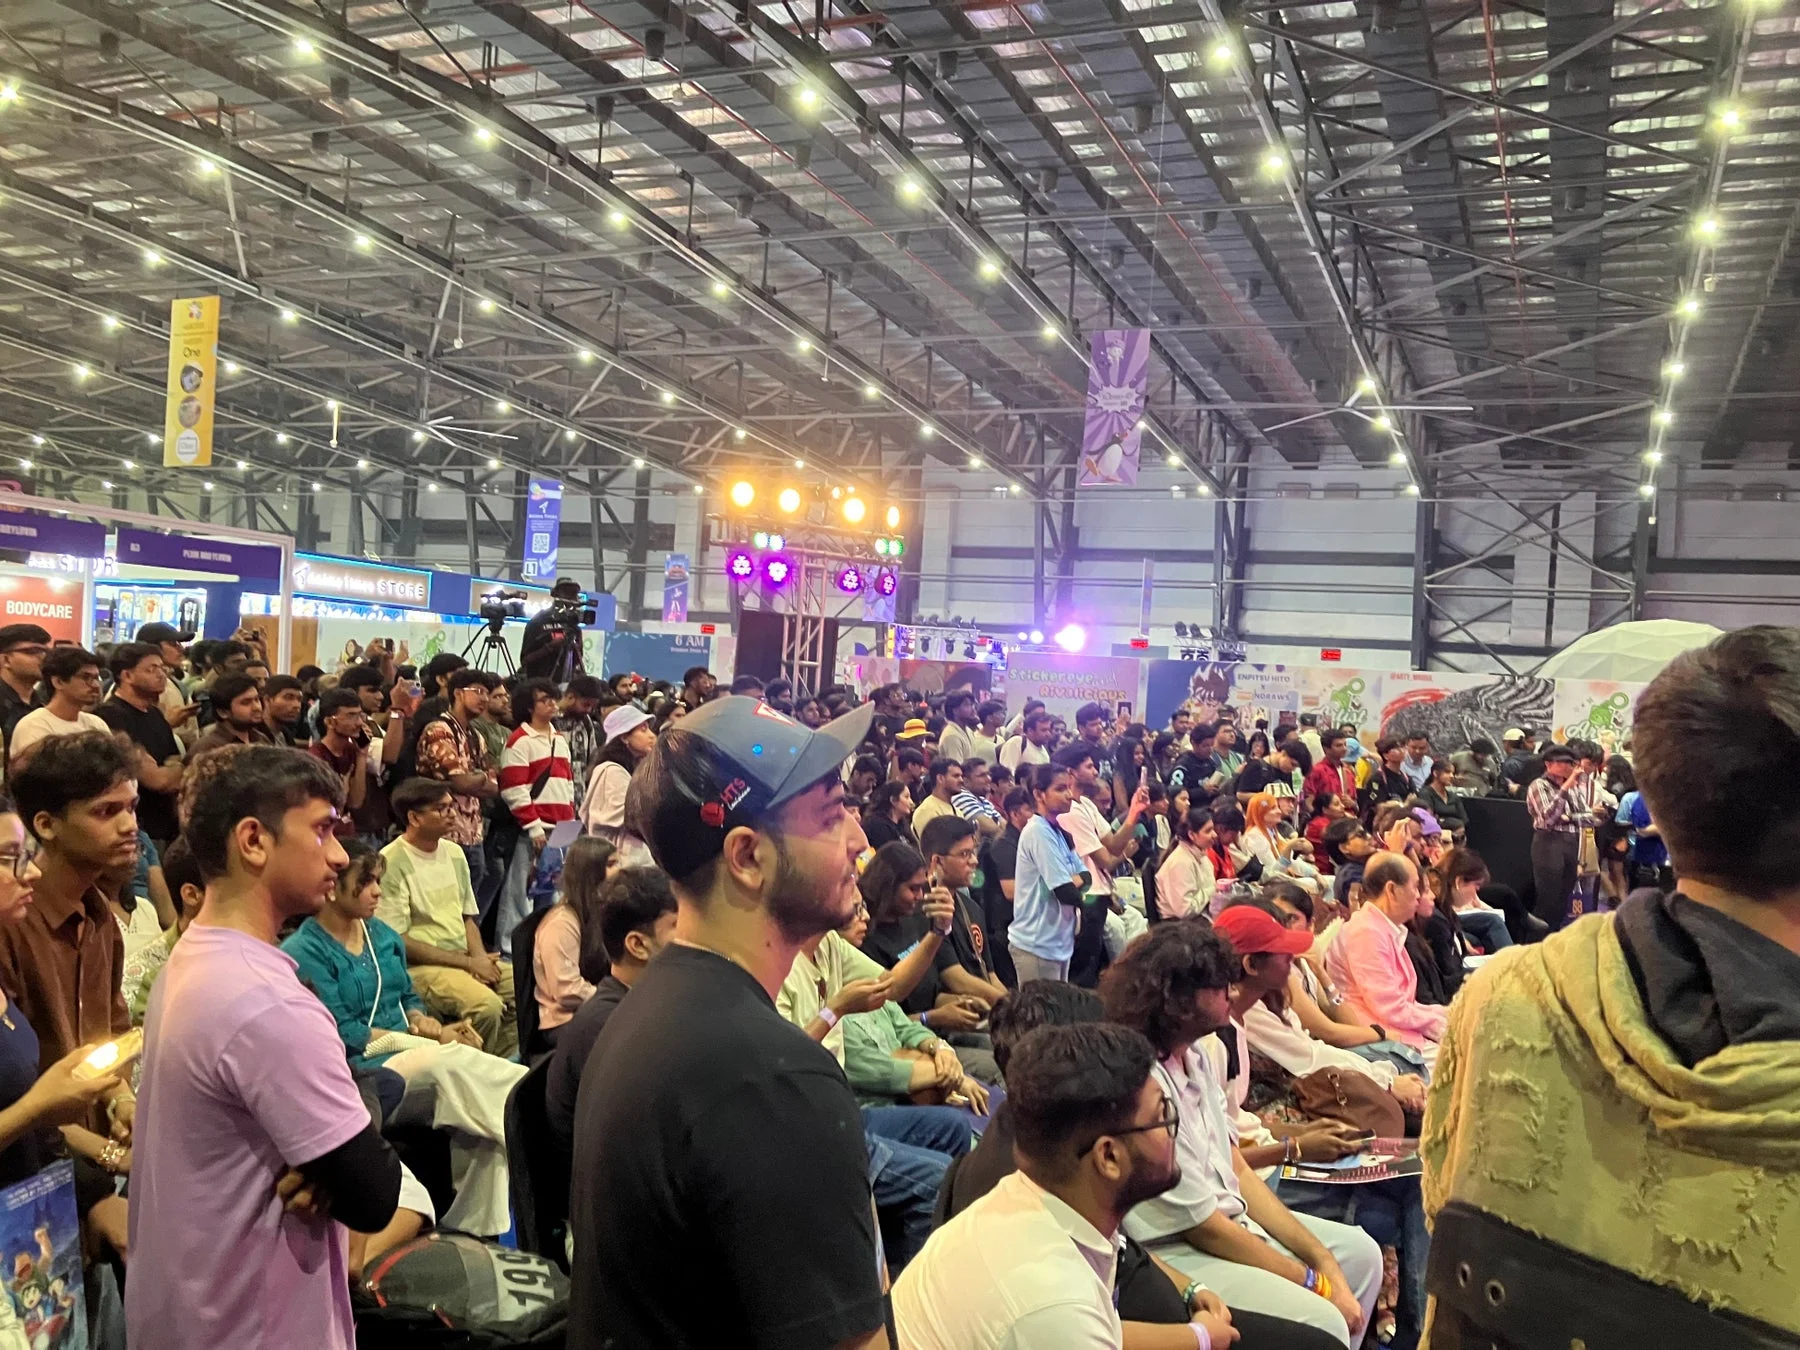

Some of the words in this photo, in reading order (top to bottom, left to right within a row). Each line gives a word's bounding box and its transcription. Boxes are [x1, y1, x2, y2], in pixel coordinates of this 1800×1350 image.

[378, 578, 424, 599] STORE
[6, 600, 73, 620] BODYCARE
[675, 635, 683, 647] 6
[686, 635, 705, 648] AM
[1237, 673, 1270, 682] ENPITSU
[1271, 675, 1290, 683] HITO
